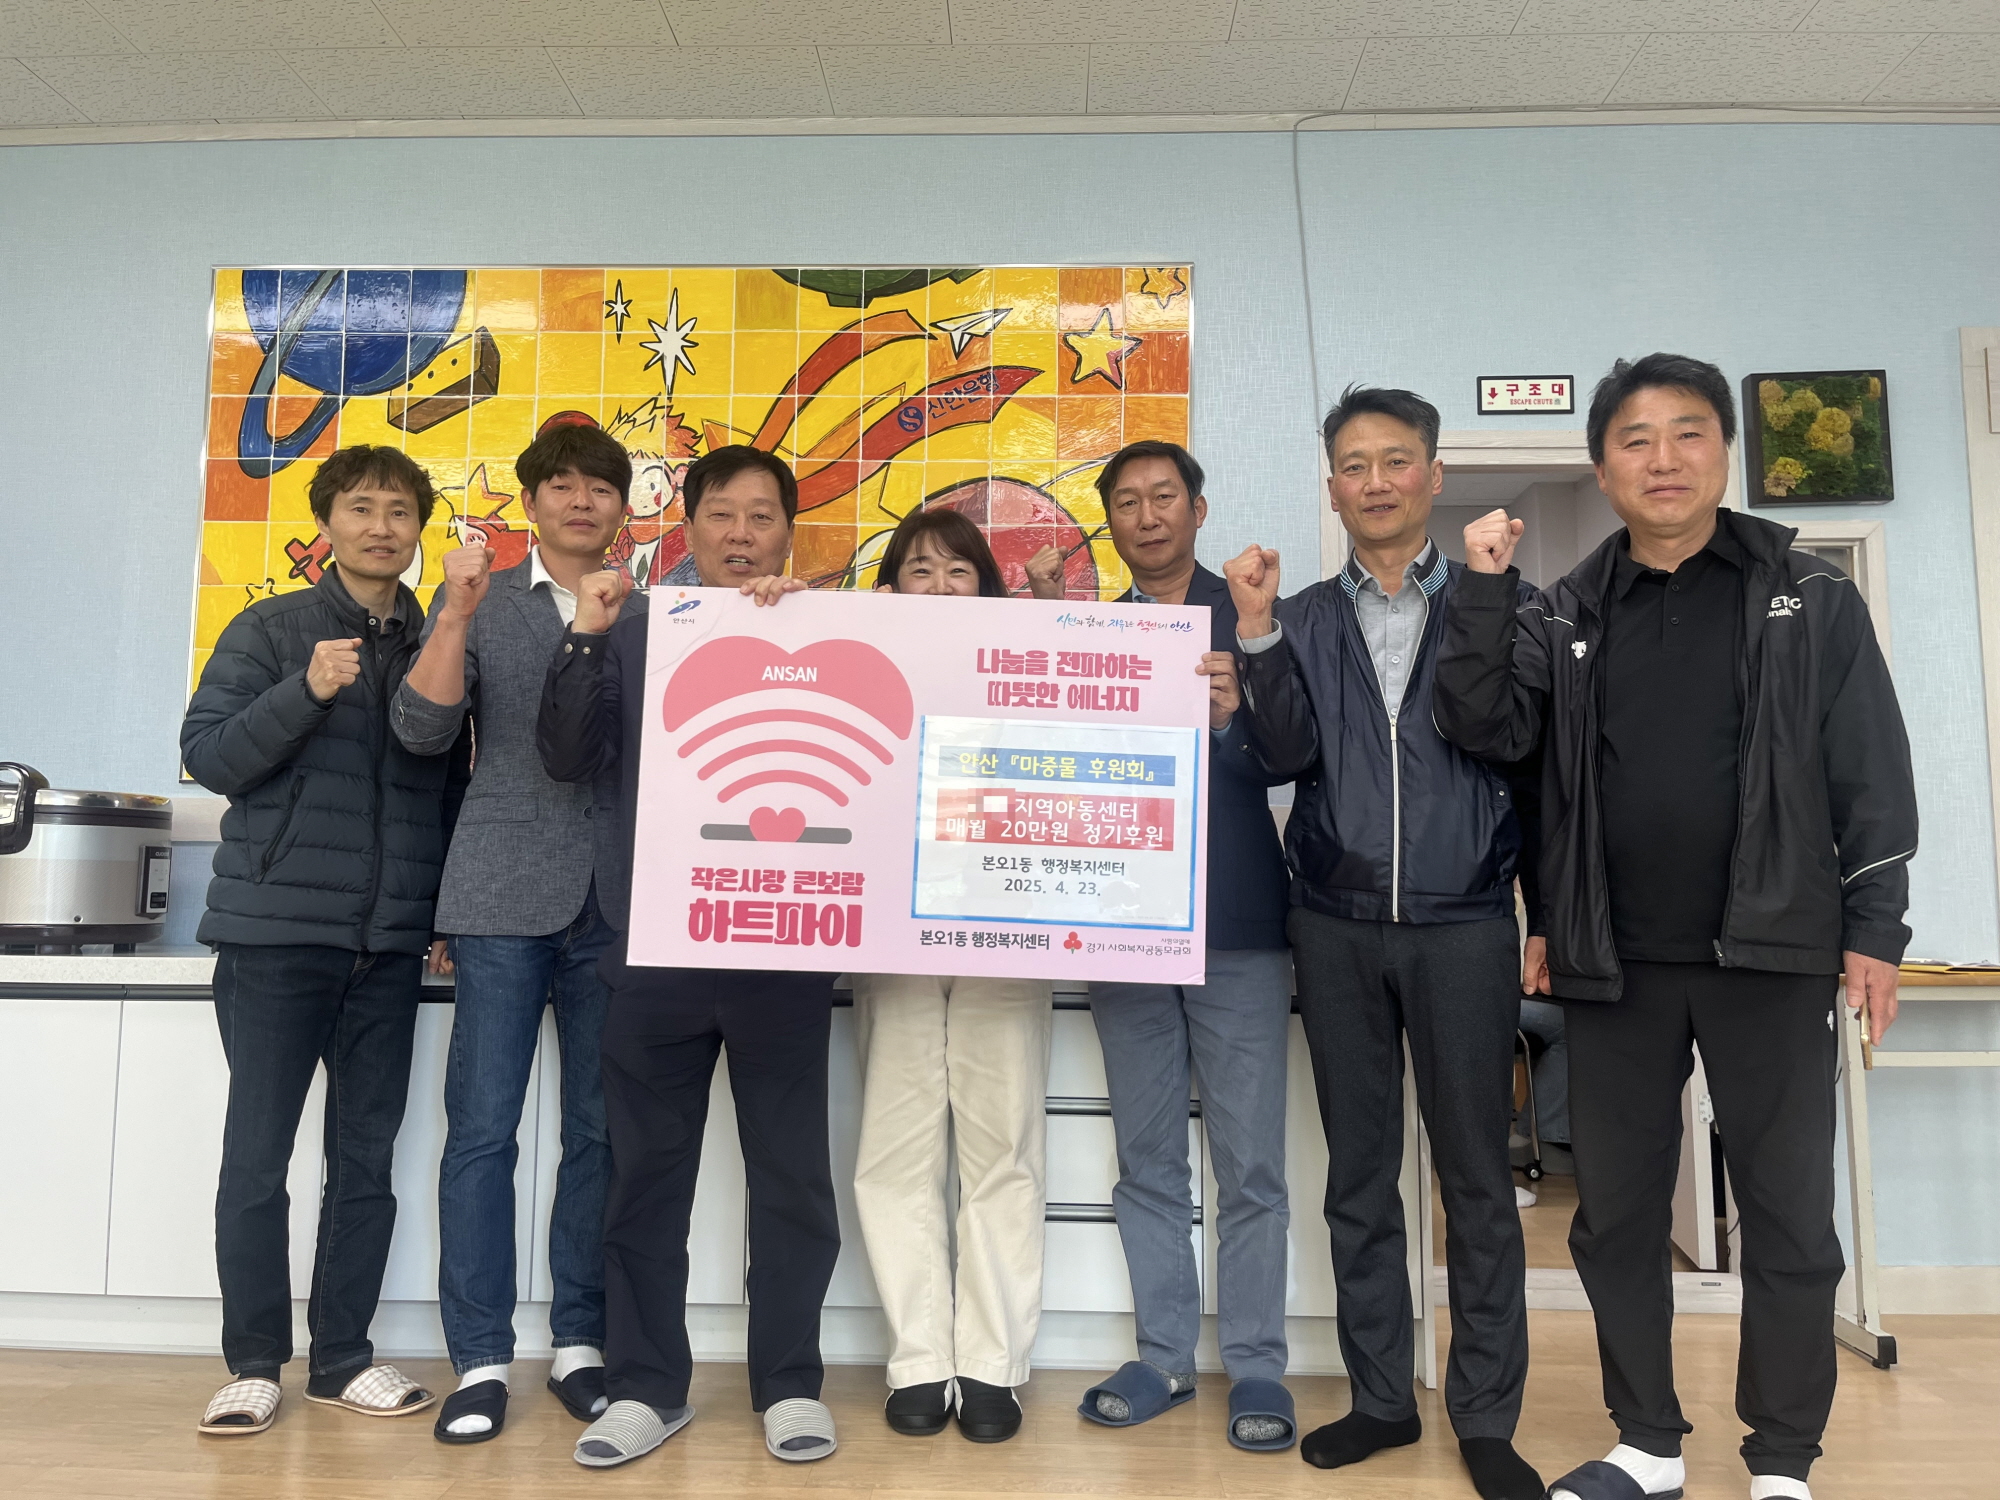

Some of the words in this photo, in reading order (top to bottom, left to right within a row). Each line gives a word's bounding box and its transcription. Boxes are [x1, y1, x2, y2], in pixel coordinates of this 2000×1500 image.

[928, 371, 1000, 419] 신한은행
[1056, 613, 1084, 629] 시민과
[1170, 620, 1194, 633] 안산
[761, 666, 818, 683] ANSAN
[976, 648, 1049, 676] 나눔을
[1056, 651, 1152, 680] 전파하는
[987, 680, 1060, 709] 따뜻한
[1067, 684, 1139, 712] 에너지
[959, 751, 998, 777] 안산
[1015, 798, 1138, 823] 지역아동센터
[945, 818, 987, 839] 매월
[1001, 819, 1069, 842] 20만원
[1083, 823, 1164, 847] 정기후원
[981, 855, 1033, 873] 본오1동
[1041, 858, 1125, 877] 행정복지센터
[691, 867, 787, 894] 작은사랑
[793, 870, 866, 896] 큰보람
[1004, 878, 1047, 894] 2025.
[1055, 880, 1069, 895] 4.
[1078, 881, 1101, 896] 23.
[688, 898, 863, 948] 하트파이
[919, 930, 968, 947] 본오1동
[971, 931, 1050, 950] 행정복지센터
[1086, 942, 1105, 954] 경기
[1108, 943, 1191, 956] 사회복지공동모금회
